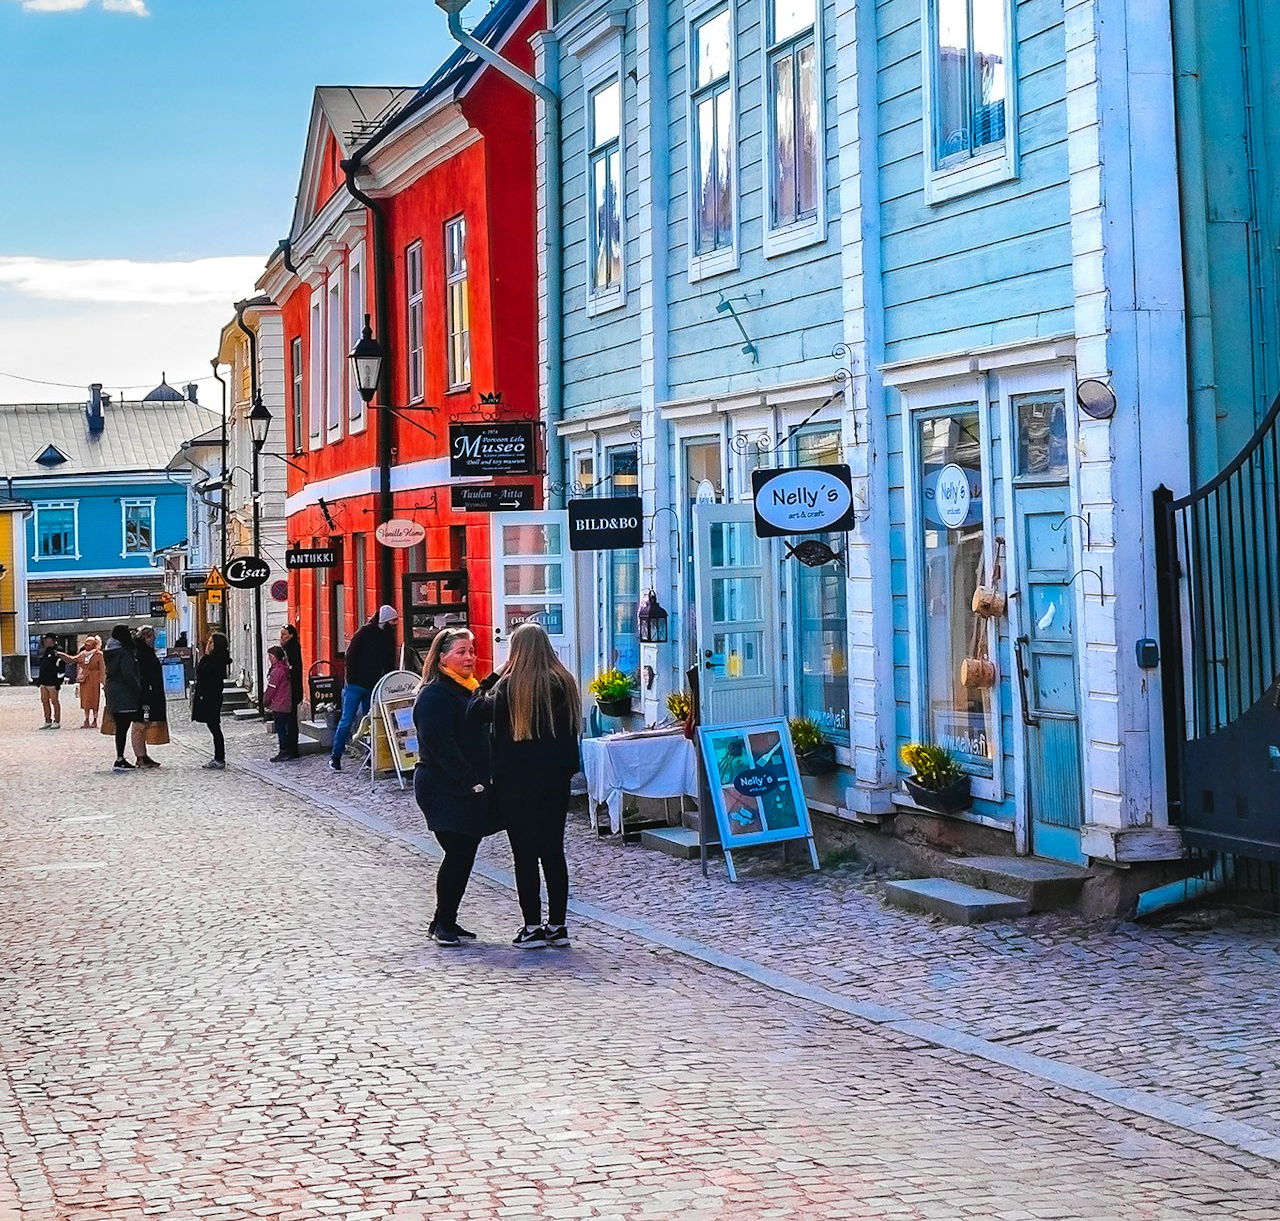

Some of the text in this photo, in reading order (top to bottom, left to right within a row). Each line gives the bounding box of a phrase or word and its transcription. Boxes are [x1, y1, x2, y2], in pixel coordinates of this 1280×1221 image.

[453, 435, 525, 459] Museo
[576, 517, 638, 531] BILD&BO
[289, 553, 334, 564] ANTIIKKI
